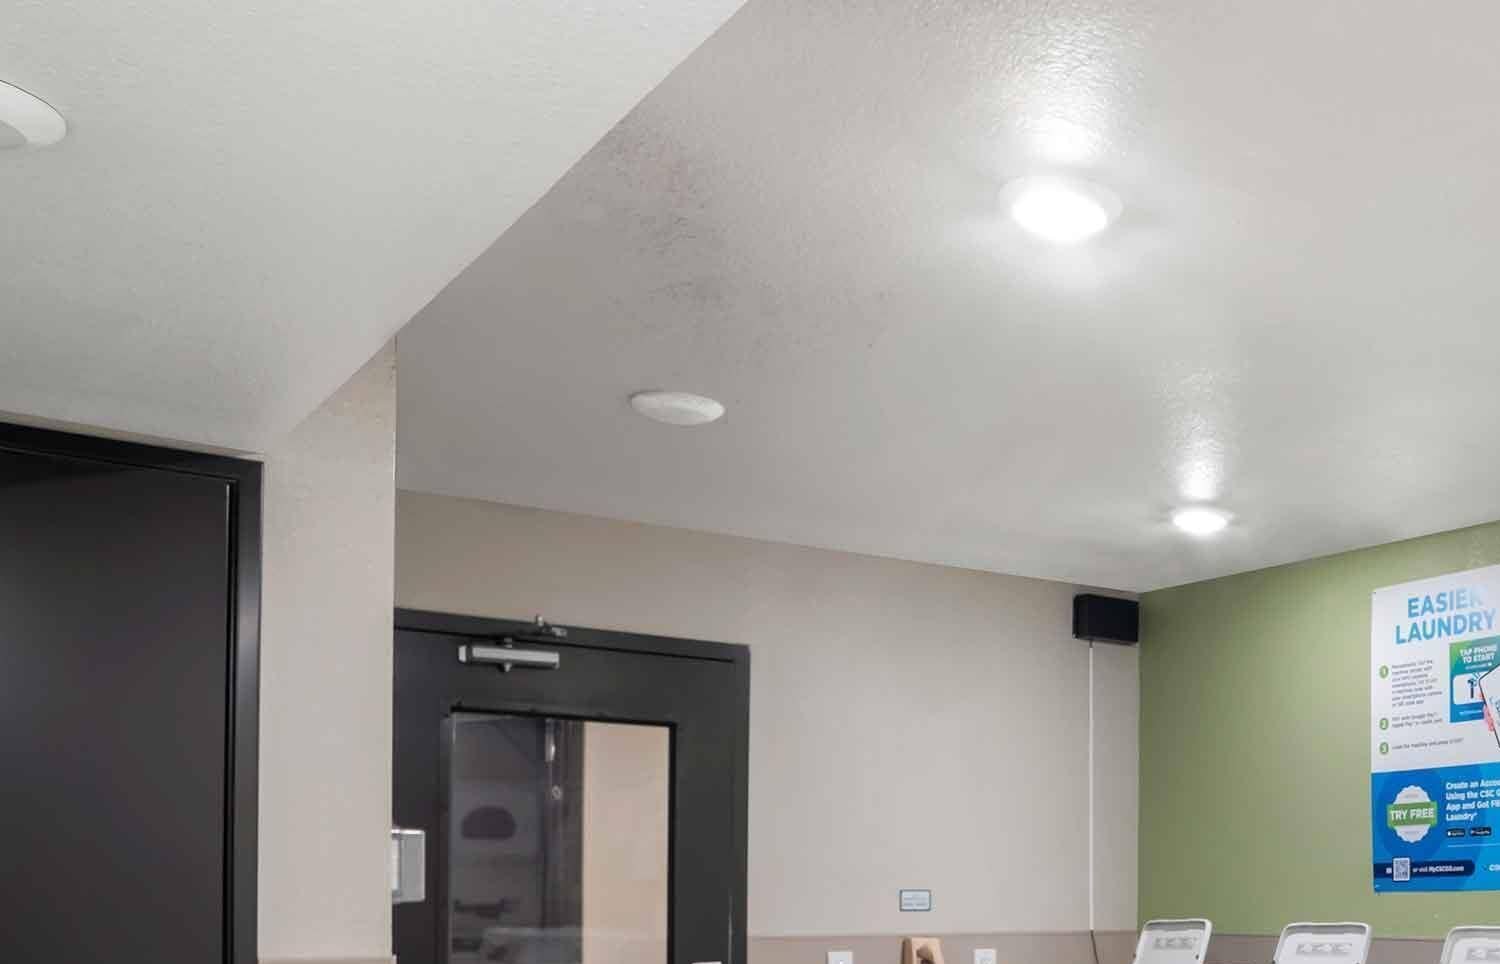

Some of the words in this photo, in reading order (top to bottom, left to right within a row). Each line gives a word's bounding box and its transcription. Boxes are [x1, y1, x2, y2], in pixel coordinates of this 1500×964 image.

[1395, 608, 1497, 644] LAUNDRY
[1446, 782, 1468, 790] Create
[1446, 791, 1465, 800] Using
[1466, 790, 1478, 798] the
[1480, 789, 1494, 798] CSC
[1446, 803, 1461, 812] App
[1462, 801, 1475, 810] and
[1390, 809, 1408, 820] TRY
[1409, 807, 1435, 820] FREE
